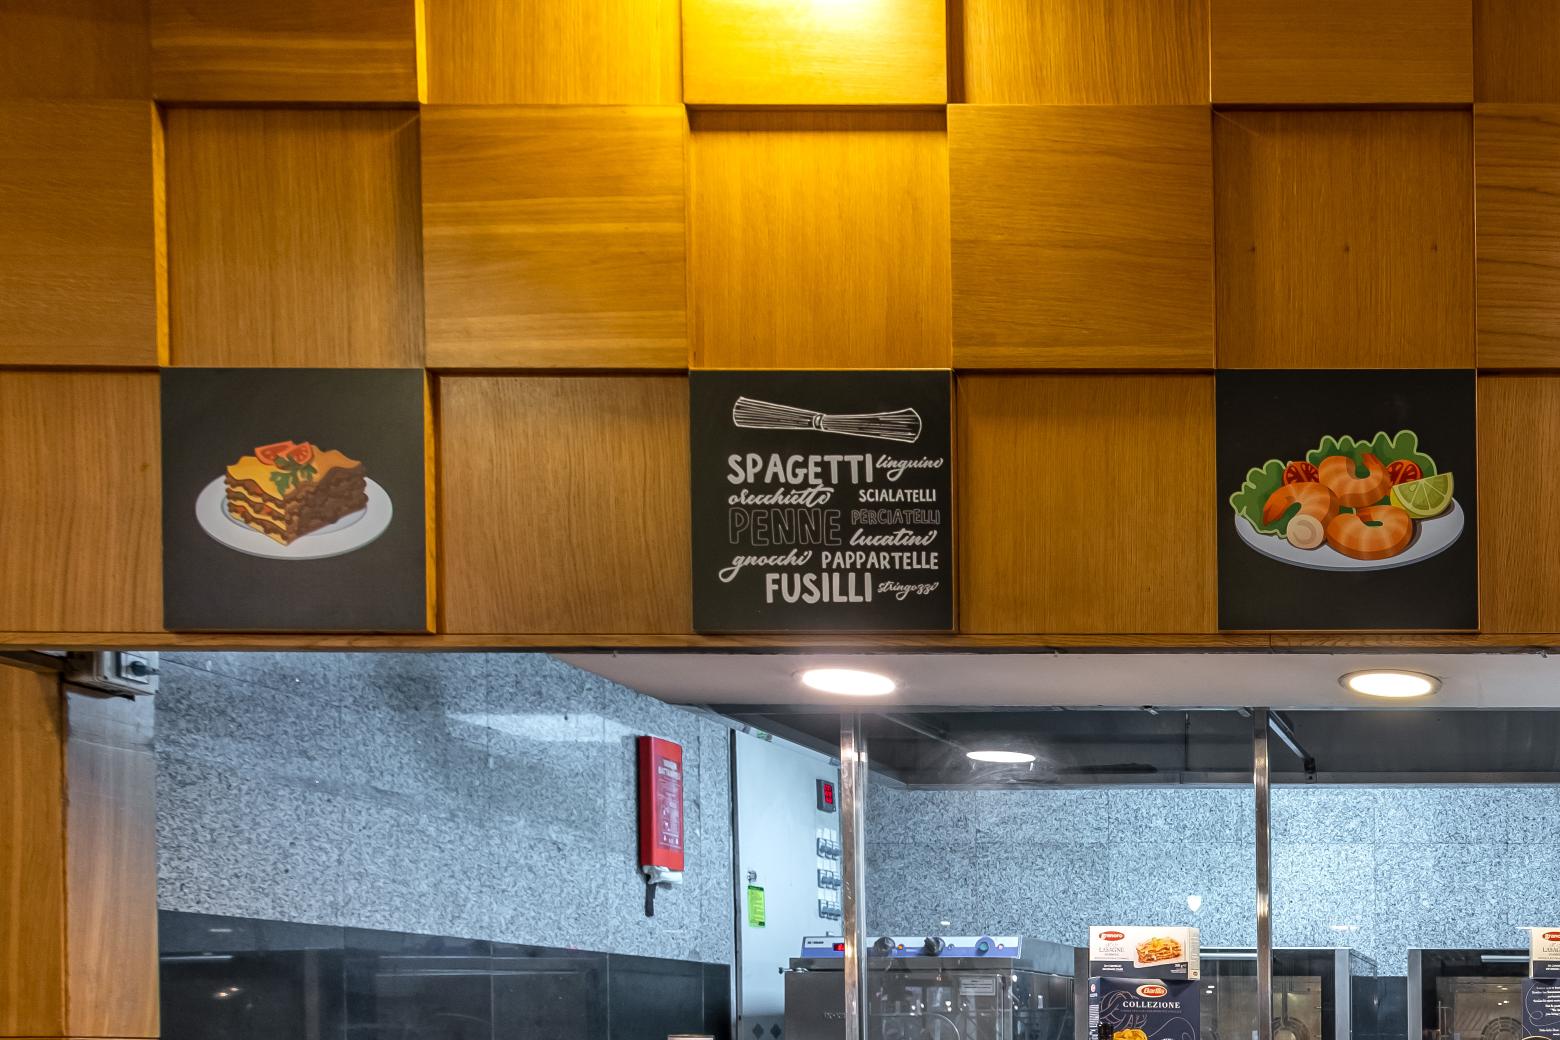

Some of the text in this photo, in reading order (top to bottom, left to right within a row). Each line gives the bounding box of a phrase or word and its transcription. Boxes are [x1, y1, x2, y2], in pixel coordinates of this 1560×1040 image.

[727, 453, 873, 485] SPAGETTI
[858, 488, 936, 502] SCIALATELLI
[728, 508, 941, 546] PENNE PERCIATELLI
[718, 548, 939, 583] gnocchi PAPPARTELLE
[765, 572, 940, 604] FUSILLI stringozzi
[1122, 1001, 1181, 1009] COLLEZIONE
